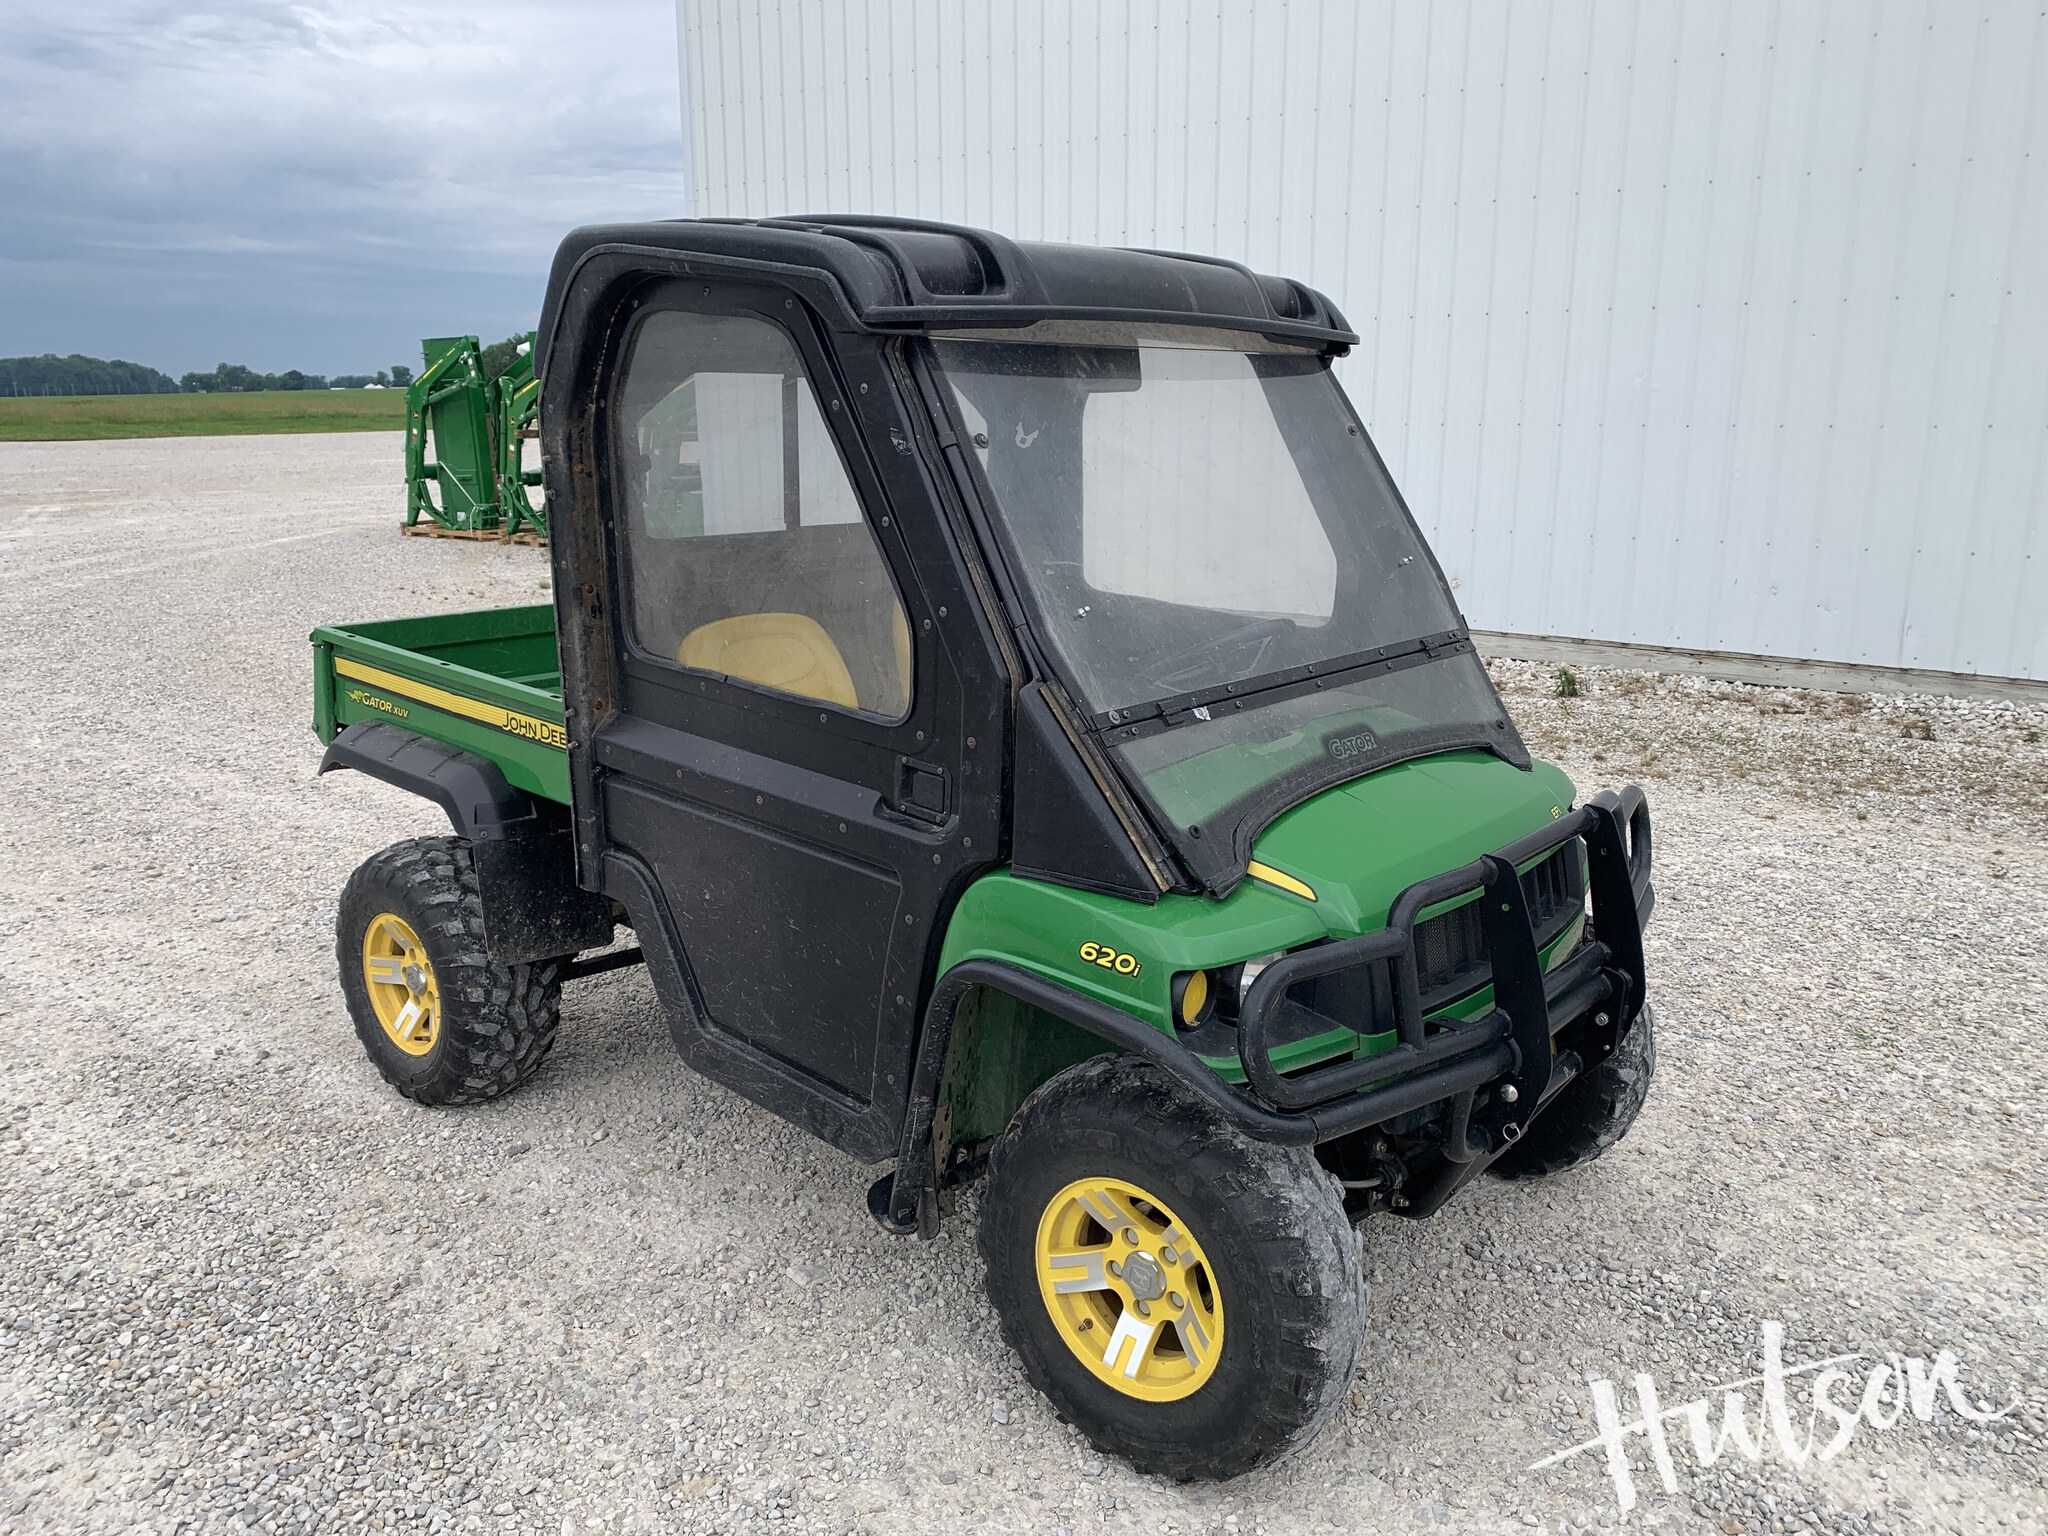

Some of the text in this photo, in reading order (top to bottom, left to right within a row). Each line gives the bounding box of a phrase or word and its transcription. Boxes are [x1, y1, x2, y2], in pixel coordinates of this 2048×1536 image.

[362, 692, 409, 718] GATOR XUV
[502, 712, 567, 747] JOHN DEE
[1328, 732, 1378, 760] GATOR
